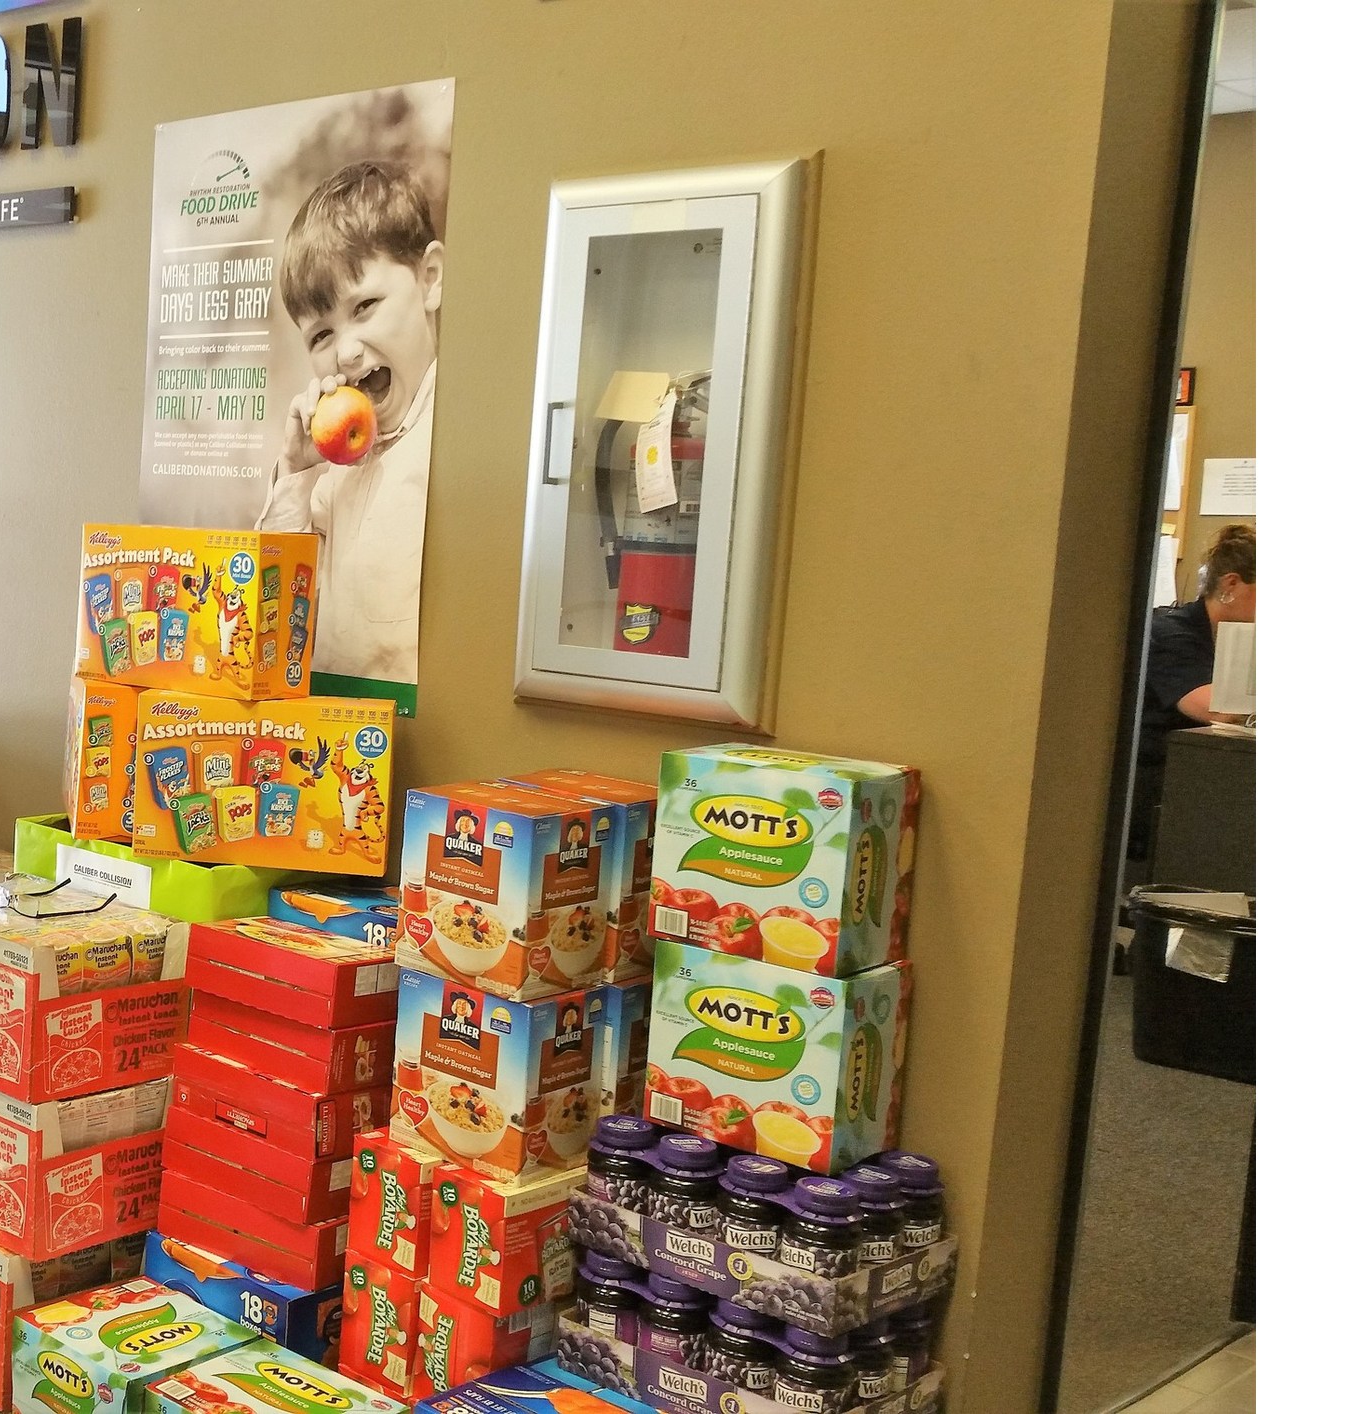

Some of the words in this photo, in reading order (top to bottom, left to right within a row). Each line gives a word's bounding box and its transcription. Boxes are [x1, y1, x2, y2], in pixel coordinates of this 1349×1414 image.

[189, 188, 212, 197] RHYTHM
[212, 183, 251, 196] RESTORATION
[180, 194, 217, 216] FOOD
[219, 191, 260, 212] DRIVE
[196, 216, 208, 227] 6TH
[209, 214, 240, 226] ANNUAL
[161, 263, 190, 289] MAKE
[192, 261, 220, 287] THEIR
[223, 257, 274, 284] SUMMER
[160, 292, 194, 323] DAYS
[199, 289, 229, 322] LESS
[234, 287, 272, 320] GRAY
[158, 345, 185, 357] Bringing
[185, 344, 200, 354] color
[201, 344, 216, 354] back
[217, 344, 225, 353] to
[225, 343, 240, 353] their
[241, 343, 271, 352] summer.
[157, 368, 207, 390] ACCEPTING
[210, 367, 267, 390] DONATIONS
[155, 395, 186, 421] APRIL
[191, 395, 203, 421] 17
[217, 395, 247, 421] MAY
[252, 395, 265, 421] 19
[152, 463, 262, 478] CALIBERDONATIONS.COM
[88, 532, 123, 548] Kellogg's
[83, 547, 160, 570] Assortment
[162, 546, 196, 568] Pack
[232, 555, 252, 574] 30
[138, 628, 156, 647] POPS
[288, 664, 301, 679] 30
[151, 701, 200, 721] Kellogg's
[142, 719, 257, 741] Assortment
[260, 718, 307, 742] Pack
[359, 729, 384, 748] 30
[684, 778, 698, 788] 36
[408, 794, 426, 806] Classic
[228, 803, 253, 823] POPS
[703, 805, 798, 839] MOTT'S
[187, 815, 211, 835] JACKS
[445, 836, 483, 856] QUAKER
[559, 847, 589, 863] QUAKER
[718, 846, 784, 866] Applesauce
[73, 863, 99, 879] CALIBER
[99, 869, 132, 887] COLLISION
[439, 861, 461, 872] INSTANT
[461, 866, 485, 878] OATMEAL
[724, 866, 763, 881] NATURAL
[428, 870, 448, 885] Maple
[453, 876, 475, 891] Brown
[474, 881, 496, 897] Sugar
[408, 925, 430, 938] Healthy
[410, 918, 427, 930] Heart
[362, 921, 387, 949] 18
[92, 943, 127, 955] Maruchan
[95, 953, 118, 963] Instant
[97, 961, 116, 969] Lunch
[678, 966, 692, 978] 36
[402, 973, 422, 985] Classic
[117, 991, 179, 1013] Maruchan
[59, 1011, 93, 1030] Instant
[118, 1013, 151, 1027] Instant
[697, 996, 791, 1035] MOTT'S
[63, 1022, 90, 1037] Lunch
[113, 1031, 147, 1047] Chicken
[149, 1027, 176, 1040] Flavor
[441, 1017, 480, 1040] QUAKER
[555, 1030, 582, 1048] QUAKER
[712, 1037, 776, 1061] Applesauce
[117, 1046, 141, 1073] 24
[141, 1042, 169, 1057] PACK
[435, 1041, 457, 1054] INSTANT
[457, 1048, 482, 1061] OATMEAL
[424, 1050, 445, 1066] Maple
[450, 1058, 472, 1074] Brown
[471, 1064, 493, 1080] Sugar
[717, 1058, 756, 1075] NATURAL
[403, 1102, 426, 1117] Healthy
[405, 1096, 422, 1108] Heart
[366, 1153, 375, 1170] 10
[60, 1167, 93, 1187] Instant
[64, 1179, 90, 1194] Lunch
[447, 1185, 456, 1202] 10
[116, 1197, 140, 1224] 24
[377, 1170, 397, 1250] BOYARDEE
[458, 1203, 479, 1287] BOYARDEE
[669, 1236, 713, 1258] Welch's
[729, 1229, 776, 1247] Welch's
[654, 1248, 695, 1270] Concord
[696, 1264, 727, 1281] Grape
[356, 1268, 365, 1286] 10
[523, 1279, 535, 1295] 10
[239, 1290, 263, 1325] 18
[18, 1330, 28, 1340] 36
[114, 1318, 160, 1336] Applesauce
[367, 1285, 387, 1365] BOYARDEE
[125, 1324, 193, 1352] MOTT'S
[267, 1351, 279, 1359] 36
[433, 1315, 454, 1392] BOYARDEE
[42, 1356, 88, 1393] MOTT'S
[662, 1372, 705, 1396] Welch's
[258, 1381, 310, 1409] Applesauce
[263, 1367, 343, 1405] MOTT'S
[647, 1384, 688, 1407] Concord
[50, 1387, 81, 1410] Applesauce
[251, 1389, 283, 1407] NATURAL
[777, 1388, 822, 1409] Welch's
